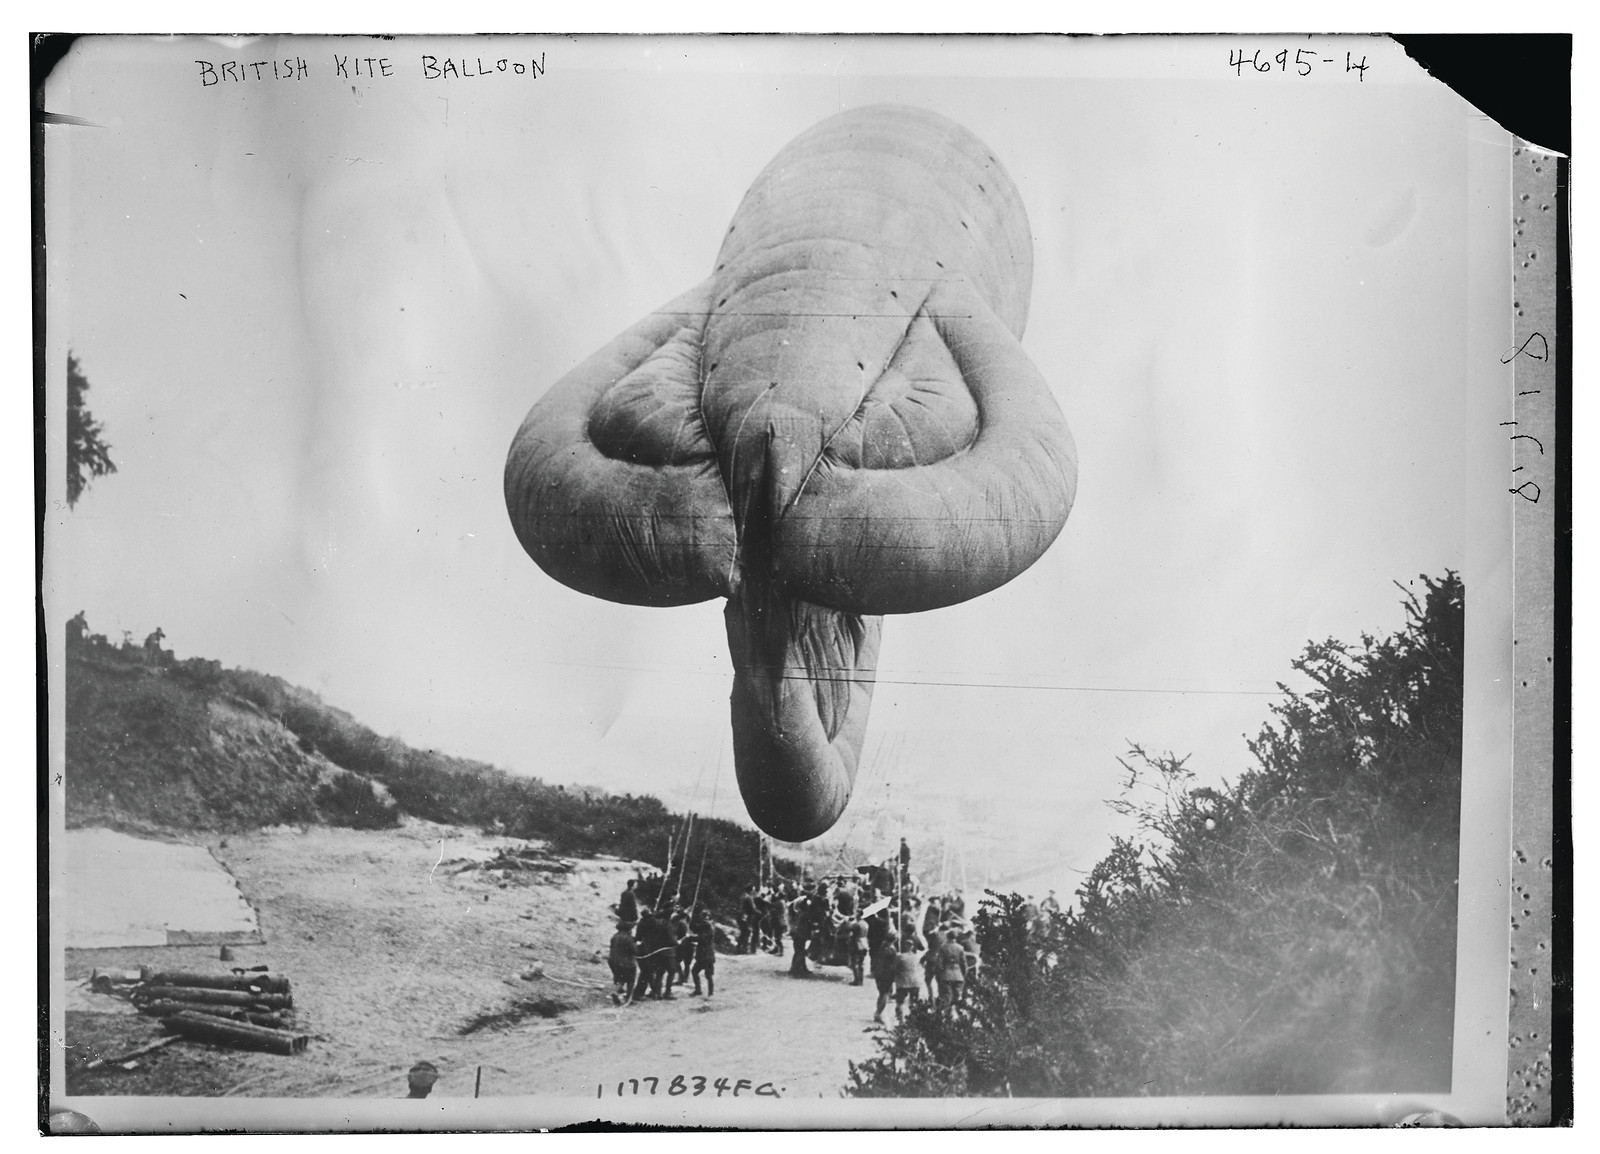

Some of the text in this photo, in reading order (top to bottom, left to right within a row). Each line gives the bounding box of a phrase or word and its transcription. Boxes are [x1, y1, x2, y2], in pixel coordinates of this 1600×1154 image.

[194, 51, 546, 87] BRITISH KITE BALLOON
